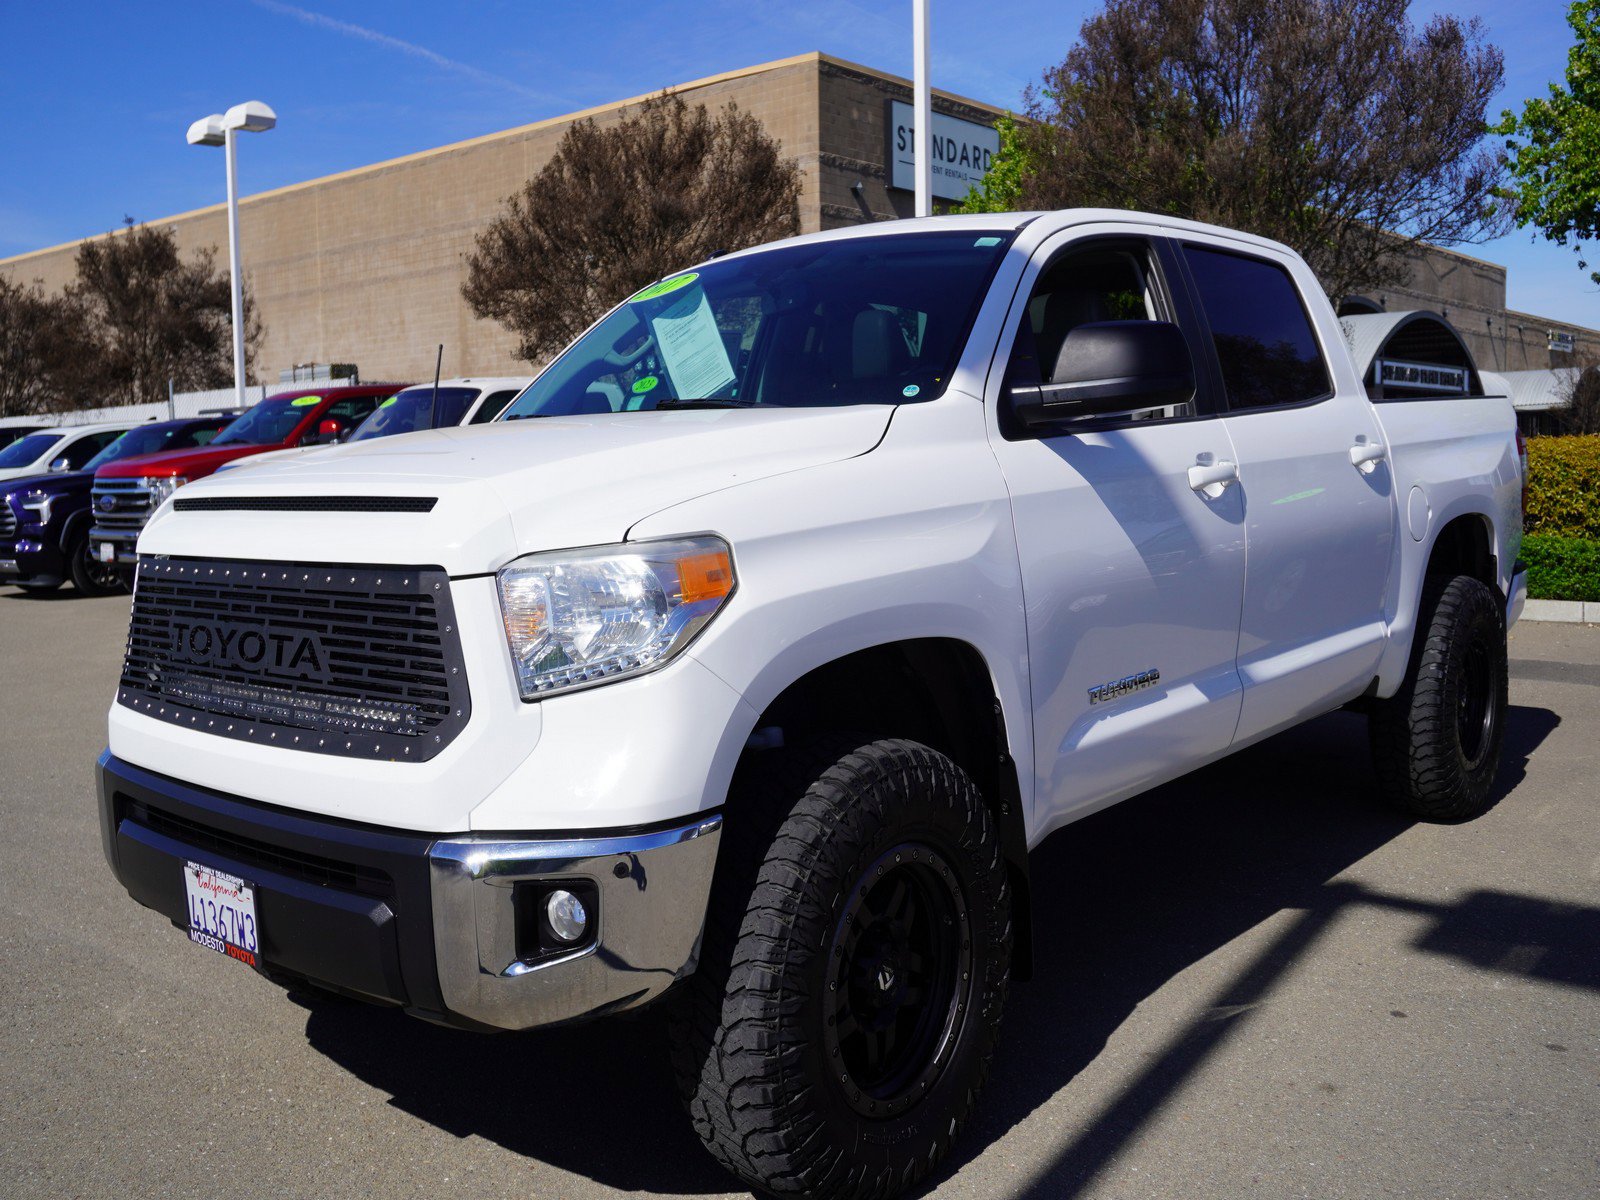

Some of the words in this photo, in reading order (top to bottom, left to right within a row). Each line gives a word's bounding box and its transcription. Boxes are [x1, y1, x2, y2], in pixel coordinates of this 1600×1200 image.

[897, 125, 992, 172] STNDARD
[172, 624, 323, 674] TOYOTA
[1088, 668, 1160, 705] TUNDRA
[191, 894, 257, 951] 41367W3
[191, 929, 225, 953] MODESTO
[225, 943, 256, 967] TOYOTA
